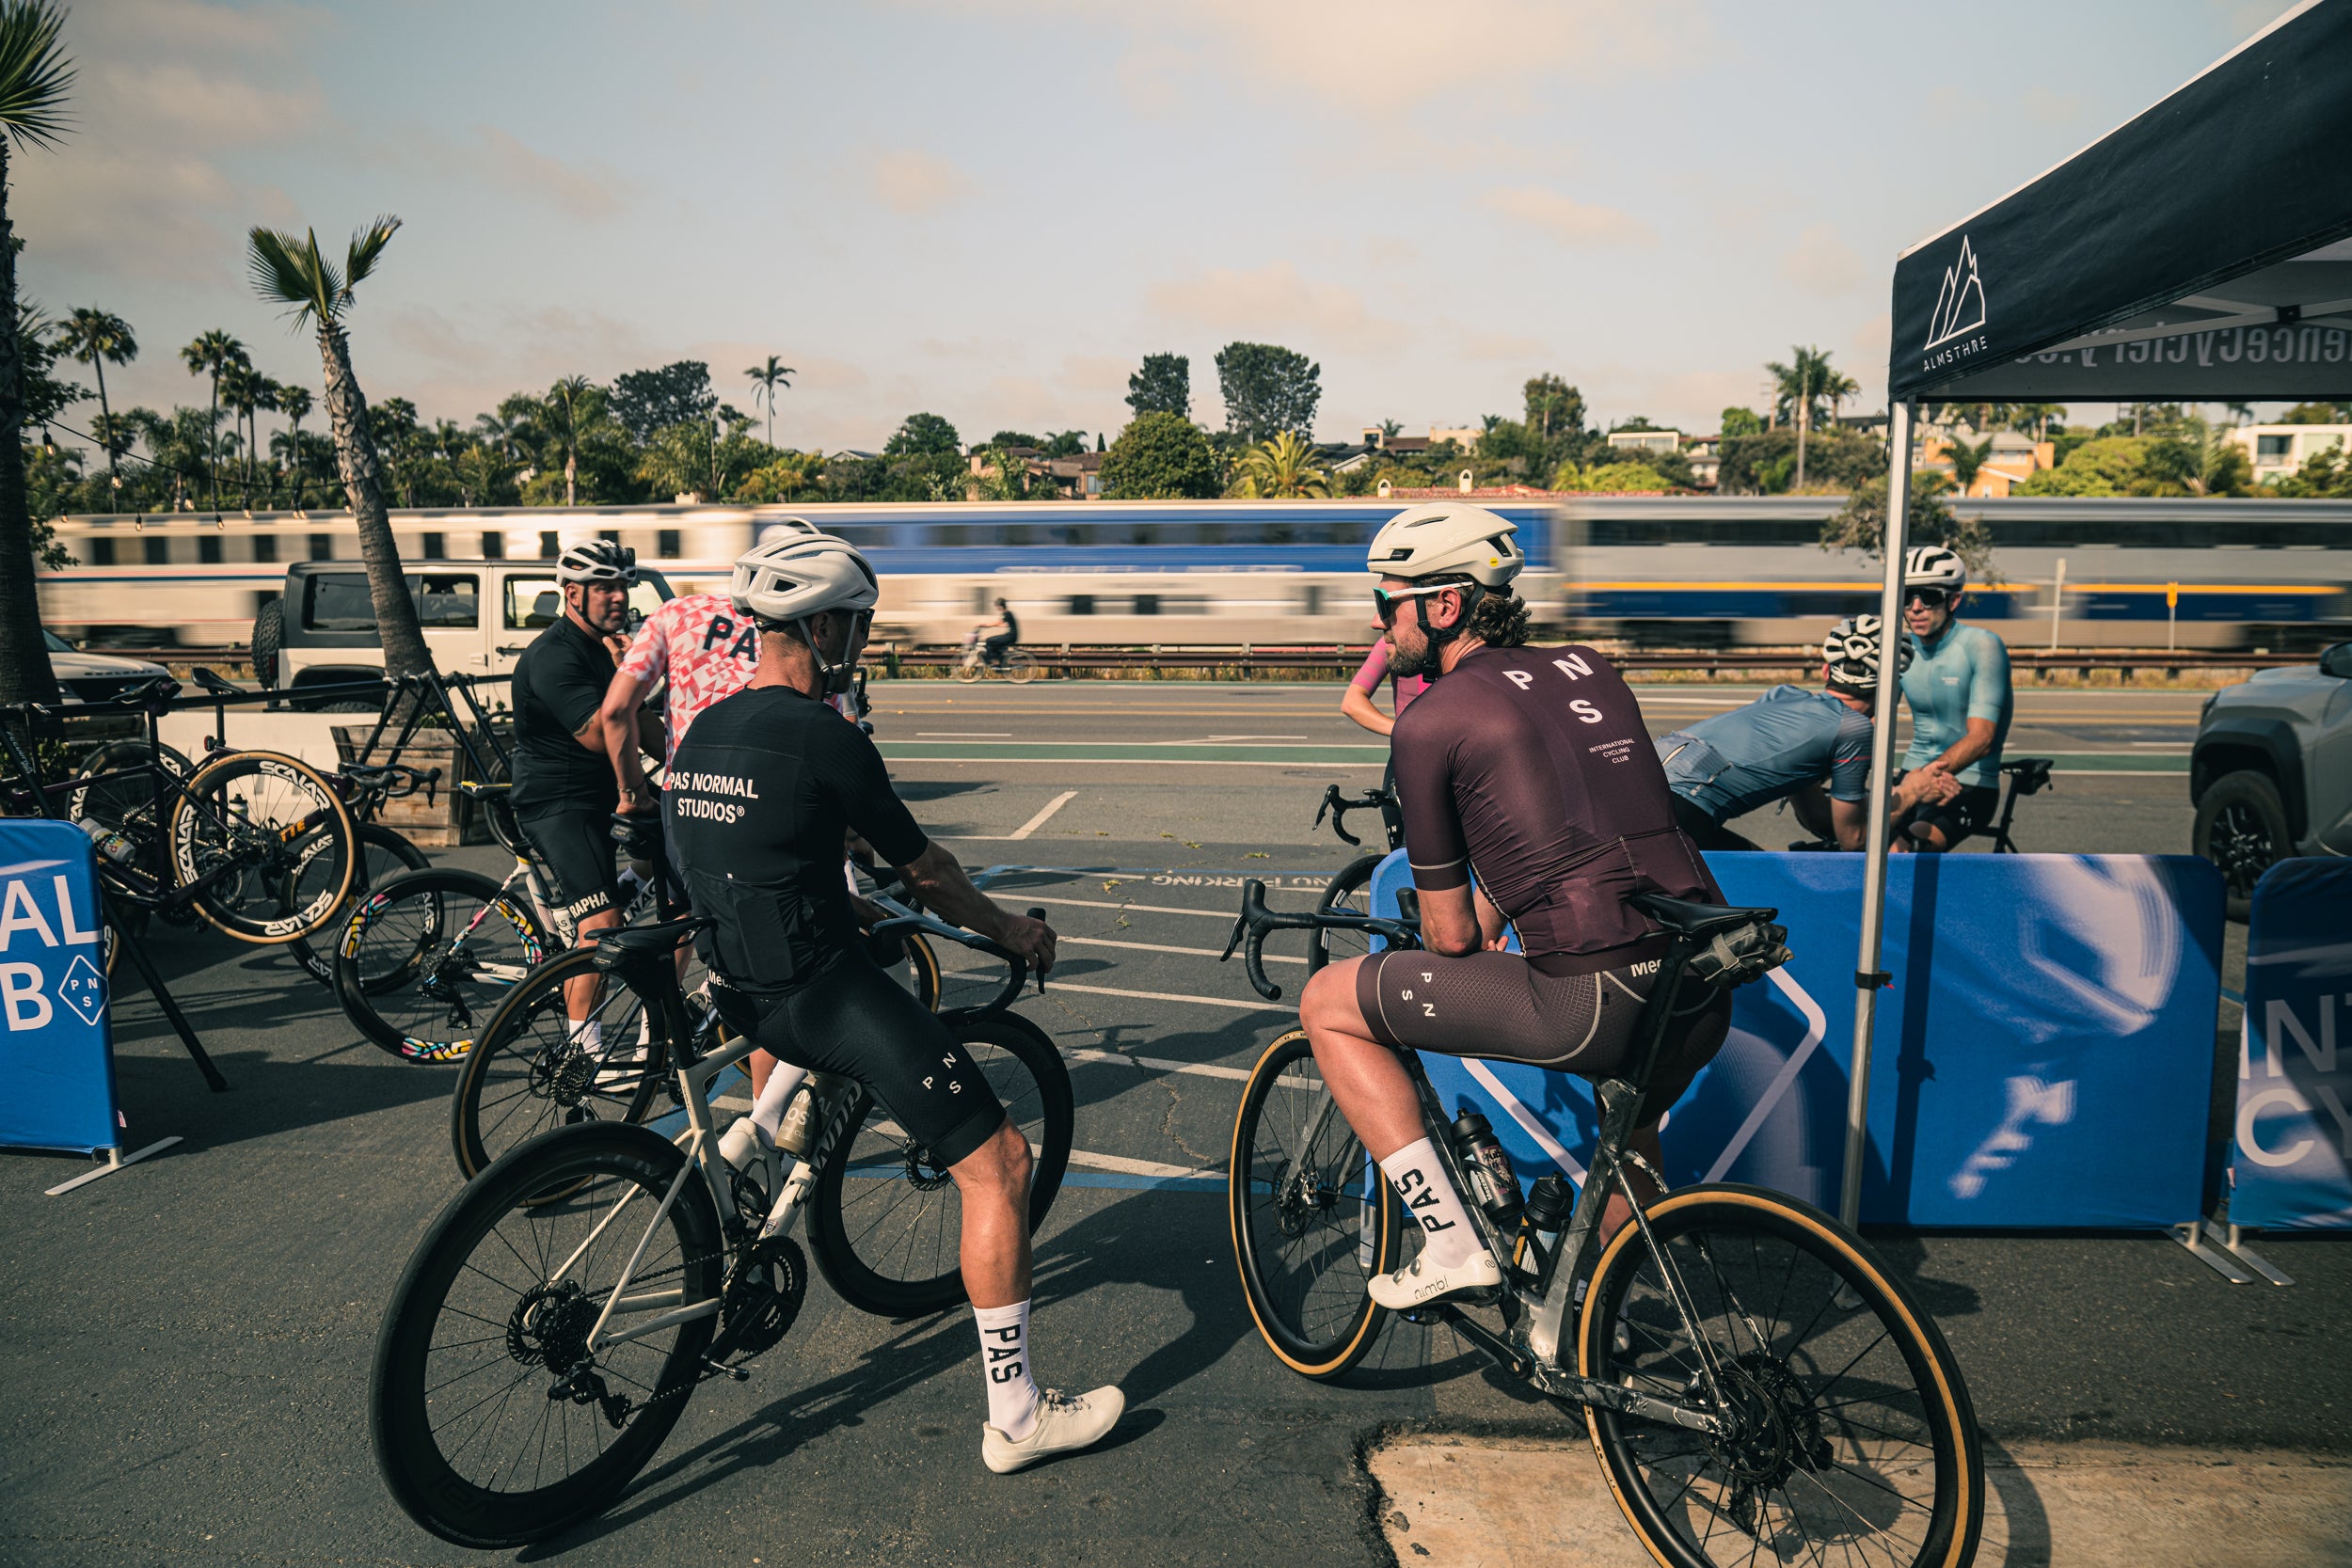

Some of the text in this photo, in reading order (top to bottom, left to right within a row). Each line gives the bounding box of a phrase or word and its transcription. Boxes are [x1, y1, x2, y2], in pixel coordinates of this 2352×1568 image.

[1502, 653, 1594, 690] P N
[1569, 699, 1603, 723] S
[1588, 737, 1635, 753] INTERNATIONAL
[1602, 746, 1630, 758] CYCLING
[1612, 754, 1629, 764] CLUB
[259, 760, 330, 812] SCALAR
[670, 771, 759, 799] PAS NORMAL
[1152, 875, 1280, 888] PRKING
[264, 889, 333, 936] SCALAR
[568, 891, 610, 919] RAPHA
[71, 976, 98, 990] P N
[1402, 989, 1413, 1002] S
[1421, 972, 1436, 1018] P N
[82, 996, 92, 1007] S
[921, 1052, 957, 1089] P N
[949, 1080, 961, 1095] S
[1394, 1168, 1455, 1233] PAS
[1414, 1275, 1449, 1300] nimbl
[984, 1323, 1023, 1384] PAS
